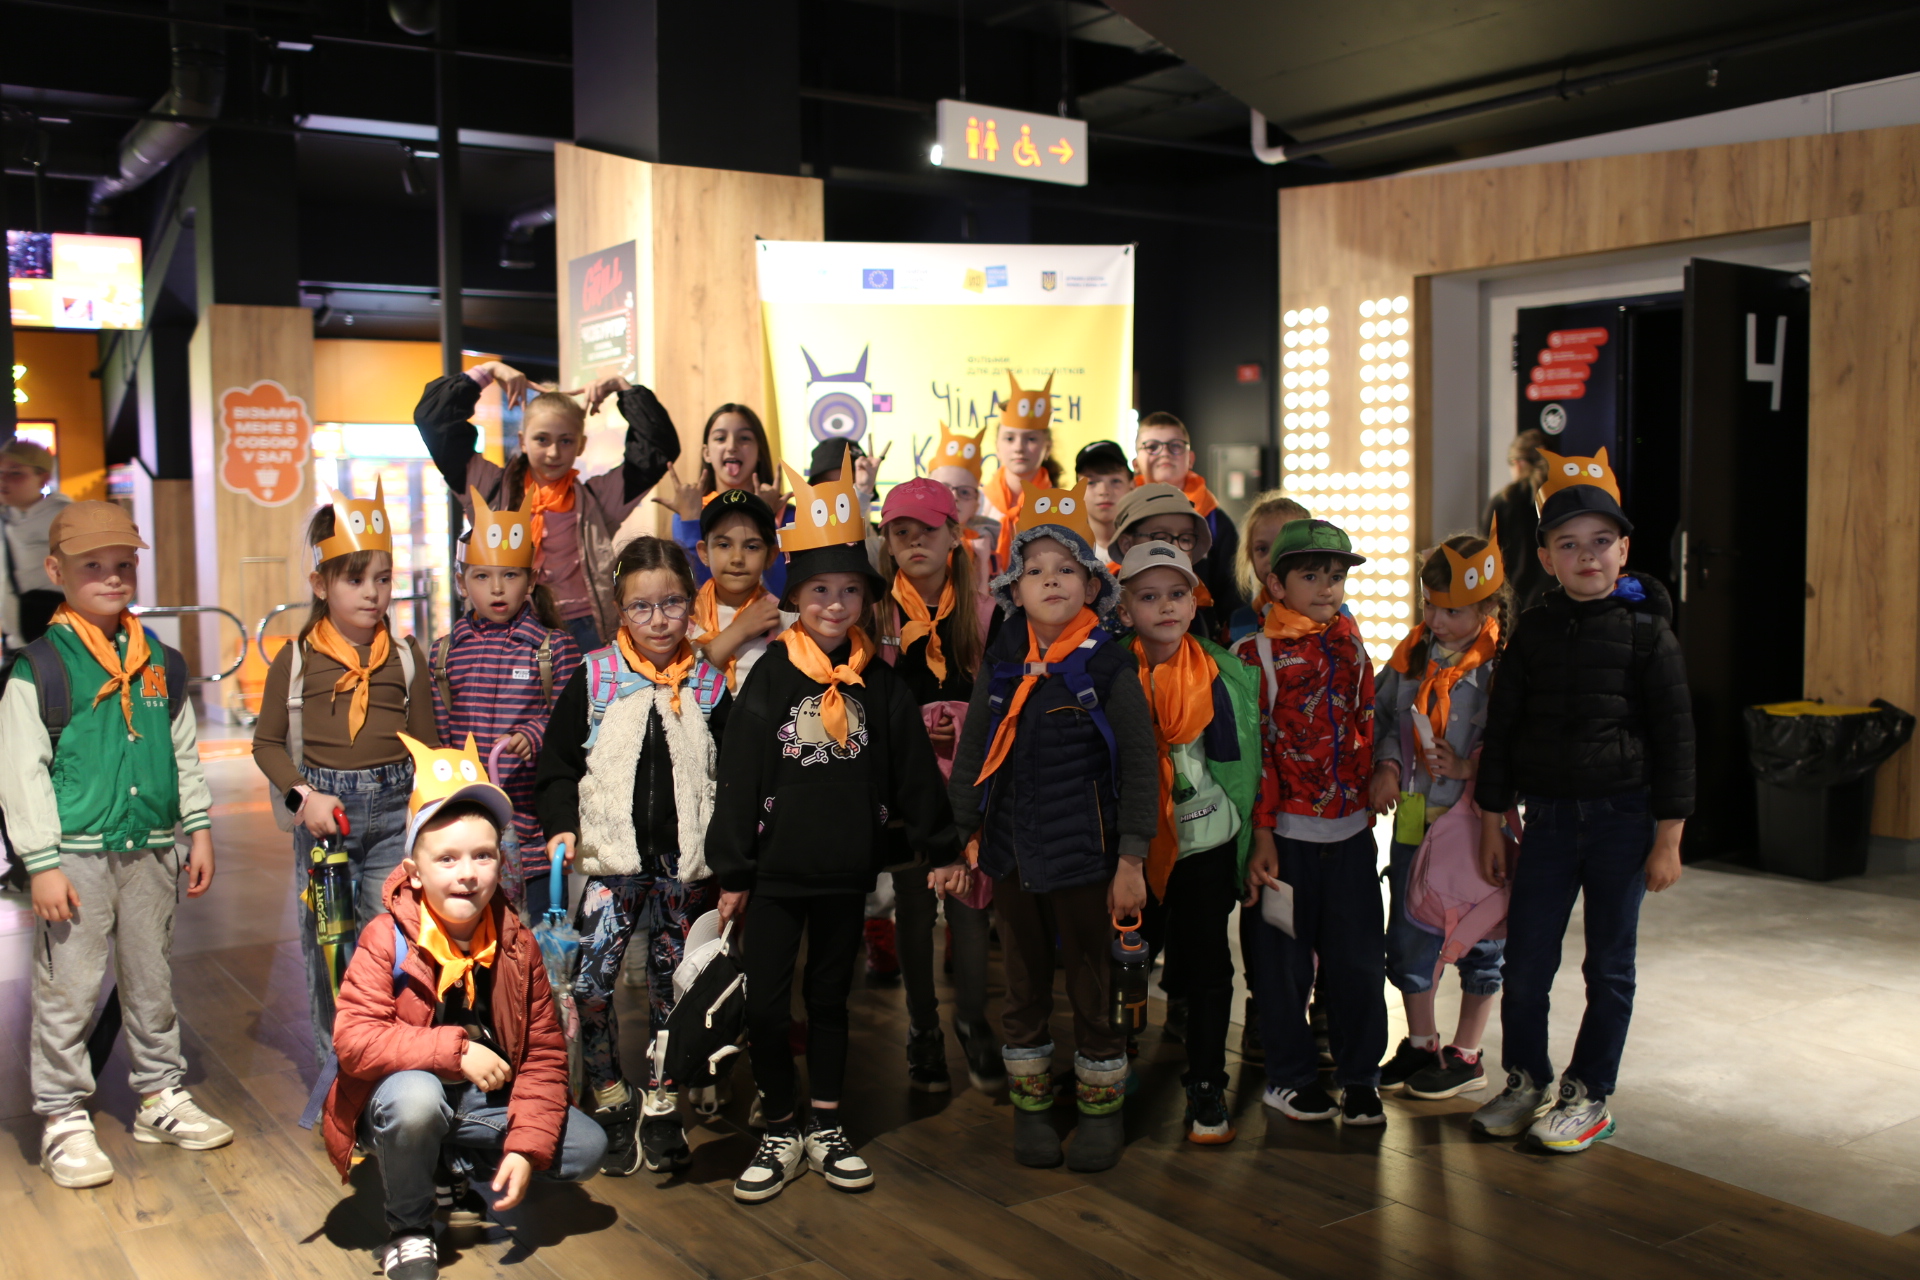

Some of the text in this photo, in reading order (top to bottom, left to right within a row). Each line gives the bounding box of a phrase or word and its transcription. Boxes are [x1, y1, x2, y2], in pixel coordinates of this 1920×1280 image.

[1746, 313, 1787, 411] 4
[234, 421, 283, 434] МЕНЕ
[234, 435, 299, 449] СОБОЮ
[256, 450, 292, 464] ЗАЛ
[140, 664, 168, 699] N
[315, 883, 328, 933] SPORT
